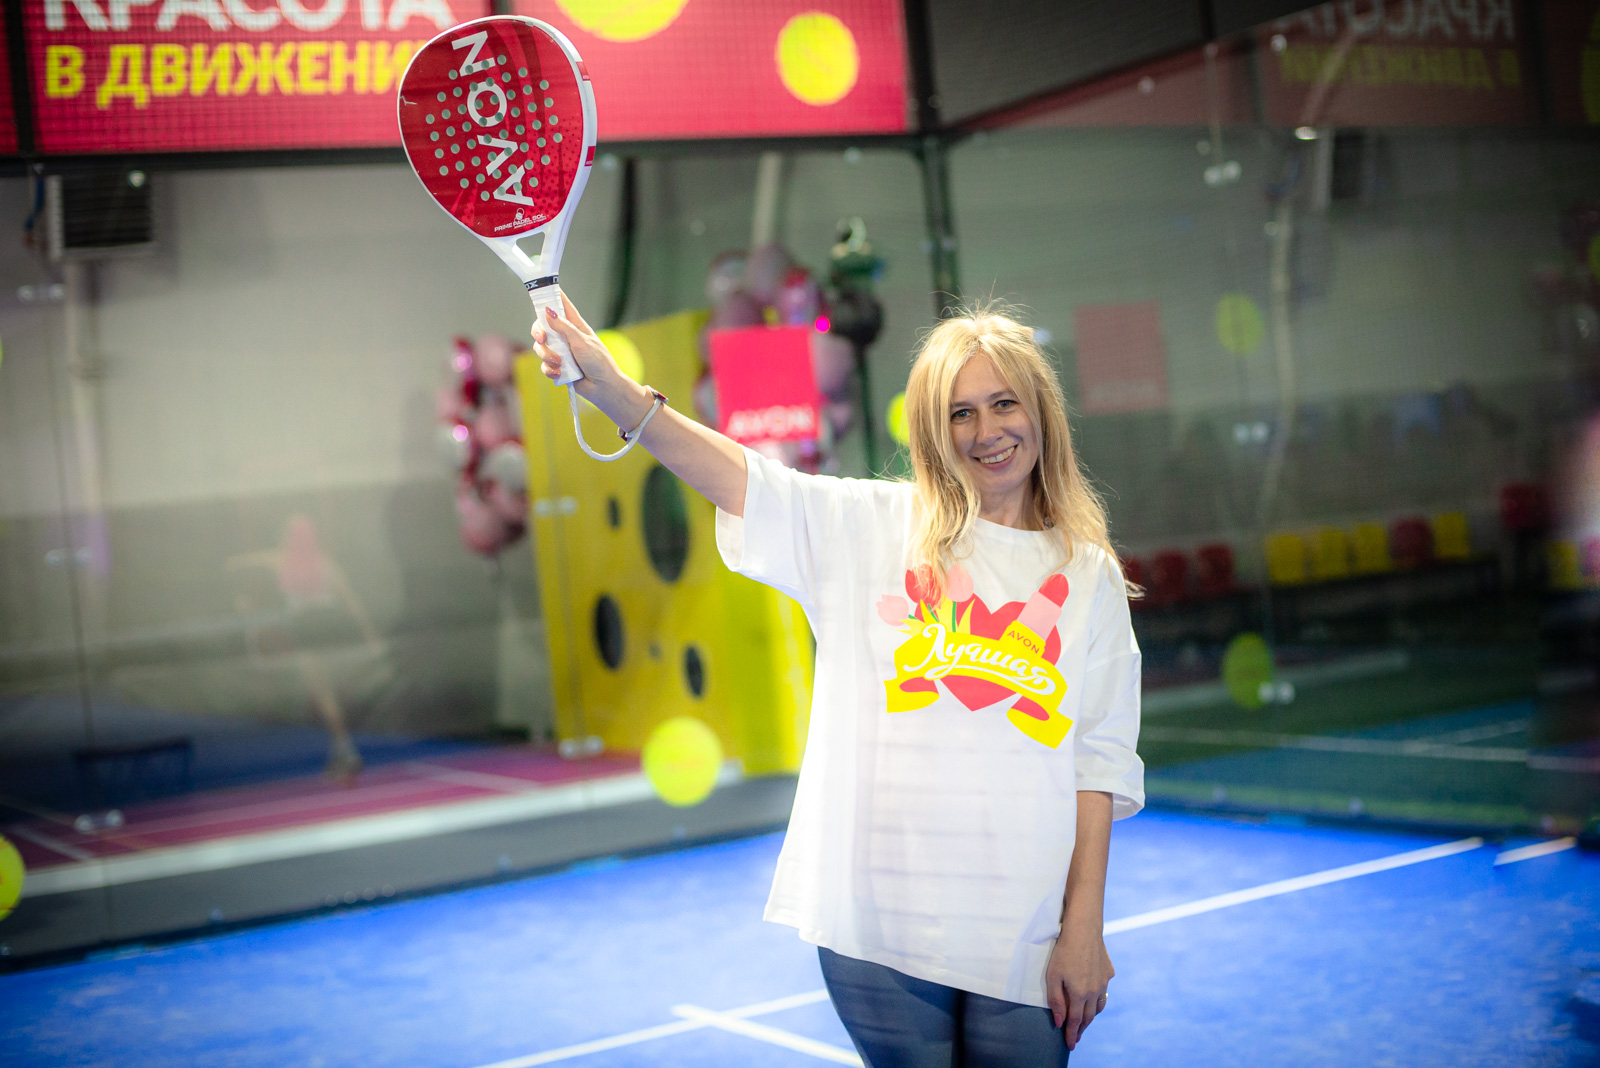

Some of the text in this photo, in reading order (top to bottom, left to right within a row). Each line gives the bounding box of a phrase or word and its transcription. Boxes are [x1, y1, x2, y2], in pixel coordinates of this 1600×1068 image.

[45, 40, 429, 109] В ДВИЖЕНИ
[451, 30, 535, 207] AVON
[494, 223, 512, 232] PRIME
[513, 217, 532, 226] PADEL
[903, 623, 1056, 695] Лучшая
[1007, 630, 1040, 654] AVON
